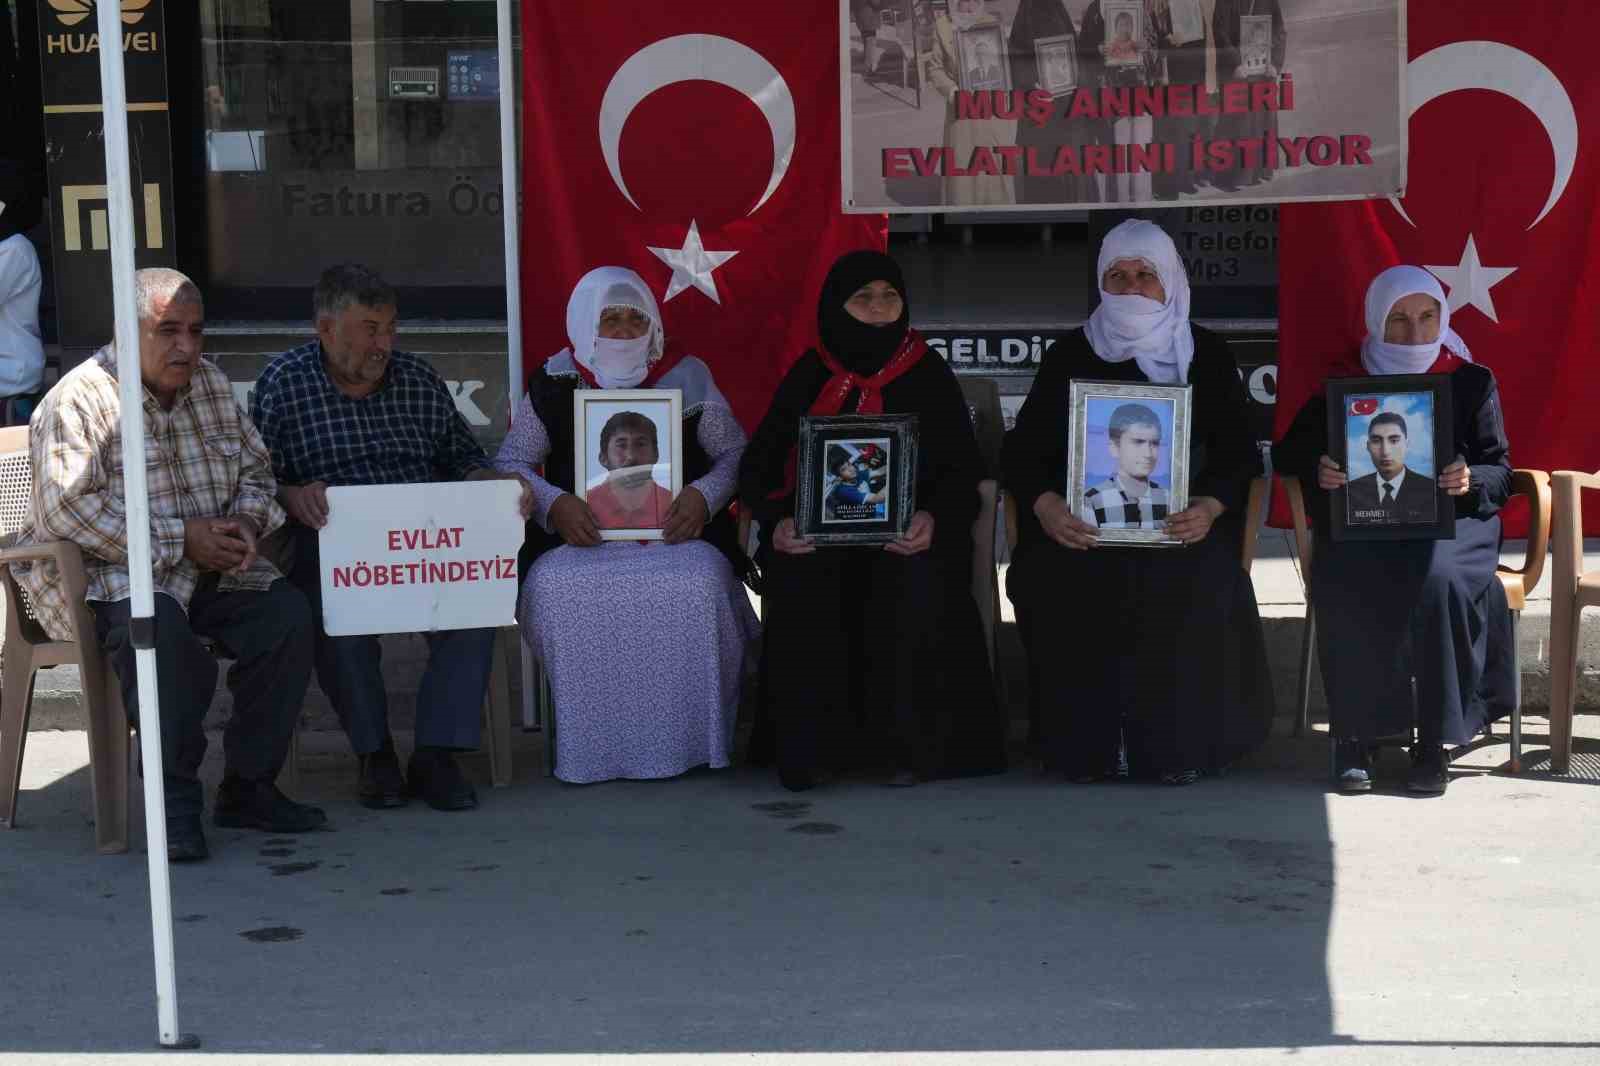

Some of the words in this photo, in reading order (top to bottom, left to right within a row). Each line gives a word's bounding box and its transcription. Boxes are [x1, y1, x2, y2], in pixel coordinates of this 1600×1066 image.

[955, 89, 1054, 127] MUŞ
[1067, 73, 1295, 119] ANNELERİ
[881, 143, 1175, 177] EVLATLARINI
[1191, 130, 1374, 173] İSTİYOR
[284, 185, 430, 216] Fatura
[388, 527, 464, 550] EVLAT
[333, 555, 516, 587] NÖBETİNDEYİZ
